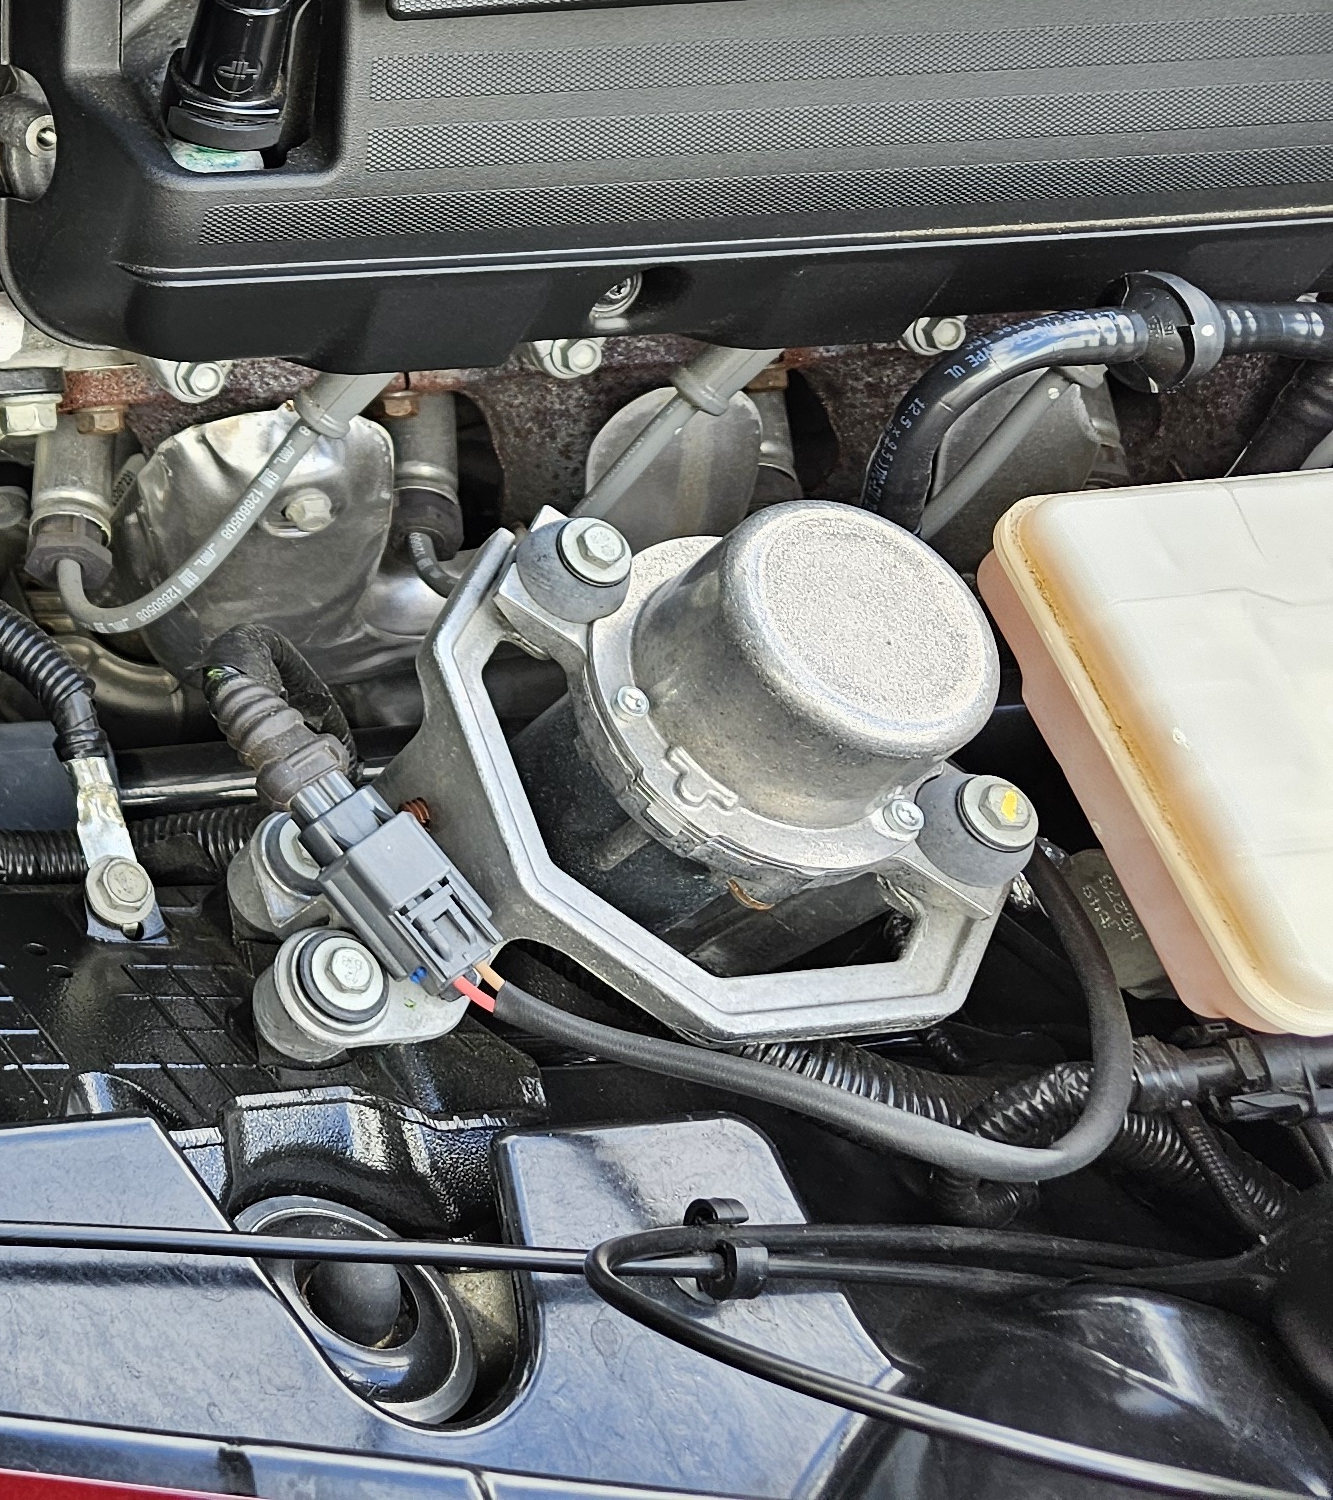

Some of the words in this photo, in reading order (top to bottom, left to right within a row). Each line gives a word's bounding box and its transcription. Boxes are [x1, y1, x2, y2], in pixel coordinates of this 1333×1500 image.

[943, 363, 966, 380] UL
[220, 488, 266, 540] 12660508
[135, 584, 183, 623] 12660508
